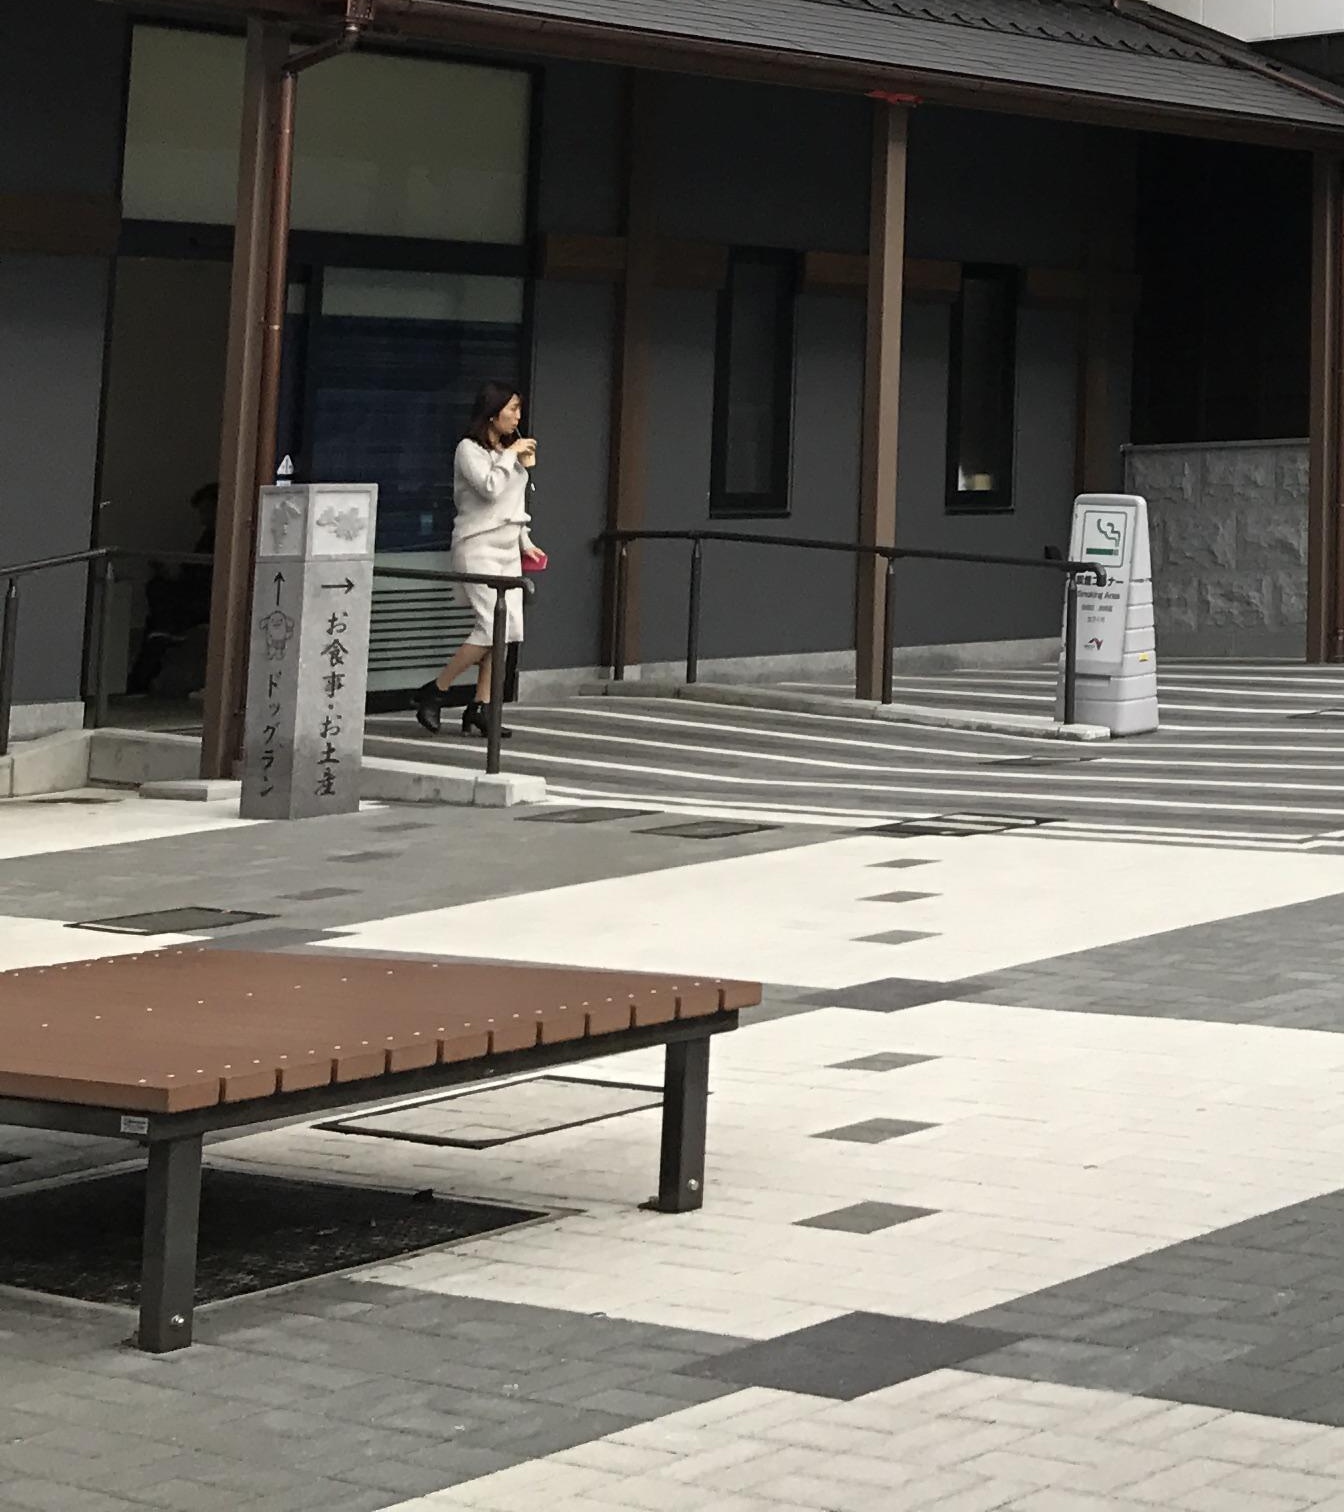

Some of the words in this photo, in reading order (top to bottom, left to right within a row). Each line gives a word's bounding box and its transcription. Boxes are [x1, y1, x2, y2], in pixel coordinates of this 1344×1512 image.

[259, 670, 284, 797] ドッグラン
[314, 611, 350, 797] お食事・お土産
